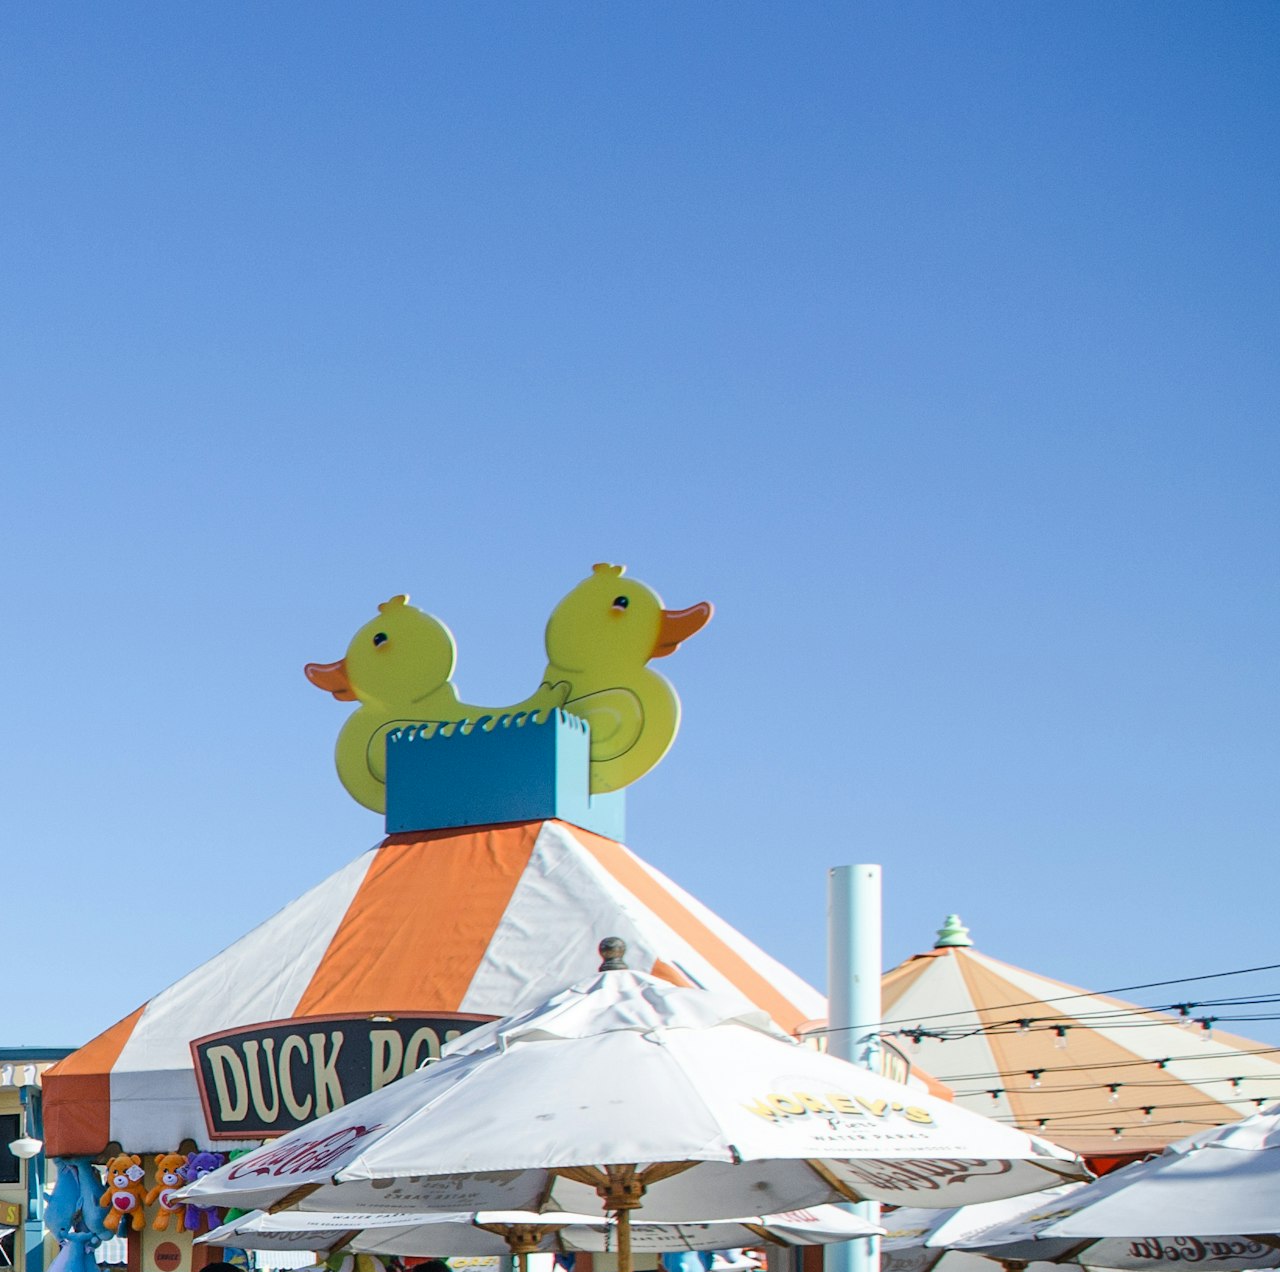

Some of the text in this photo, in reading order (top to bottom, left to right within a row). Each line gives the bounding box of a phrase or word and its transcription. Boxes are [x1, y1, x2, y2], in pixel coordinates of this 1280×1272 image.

[206, 1026, 463, 1124] DUCK PO
[740, 1091, 934, 1125] MOREY'S
[872, 1132, 931, 1141] PARKS
